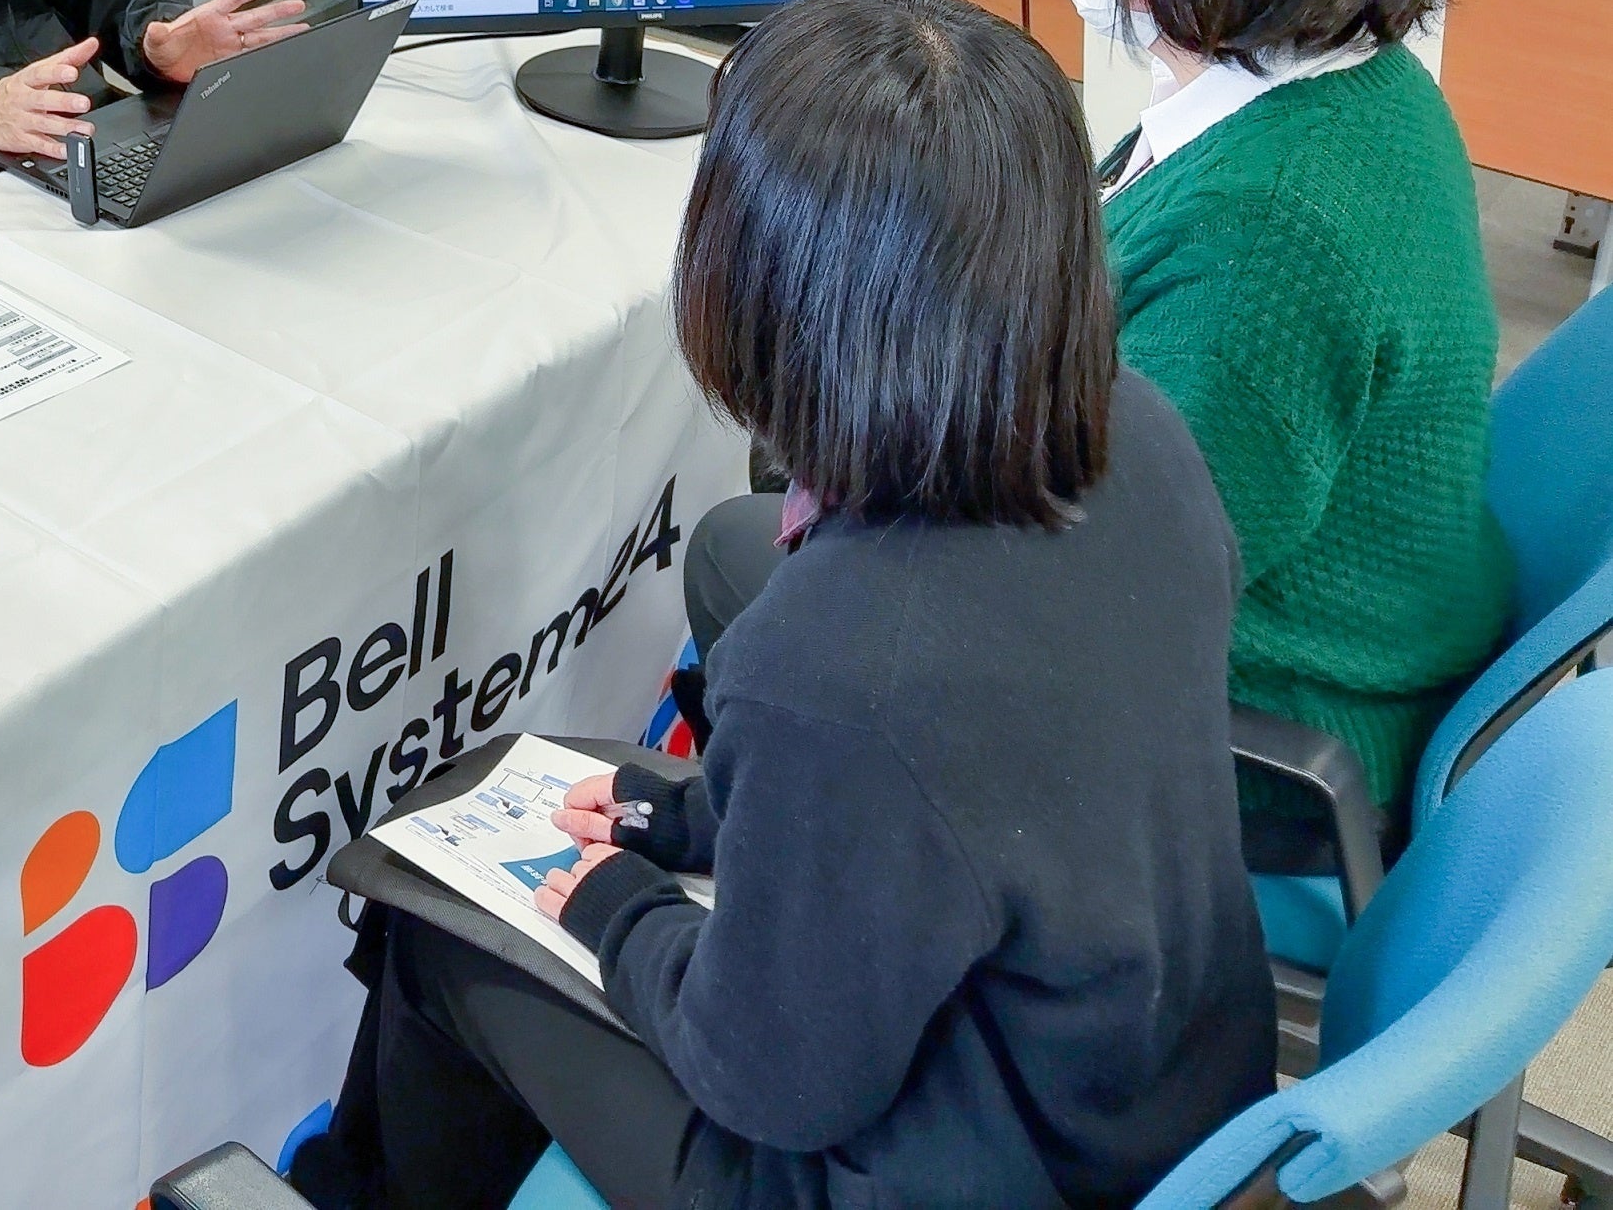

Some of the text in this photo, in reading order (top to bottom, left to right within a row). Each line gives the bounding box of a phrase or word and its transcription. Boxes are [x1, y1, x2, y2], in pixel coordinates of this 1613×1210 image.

[199, 71, 232, 101] ThinkPad
[269, 473, 681, 891] System24
[278, 548, 454, 776] Bell
